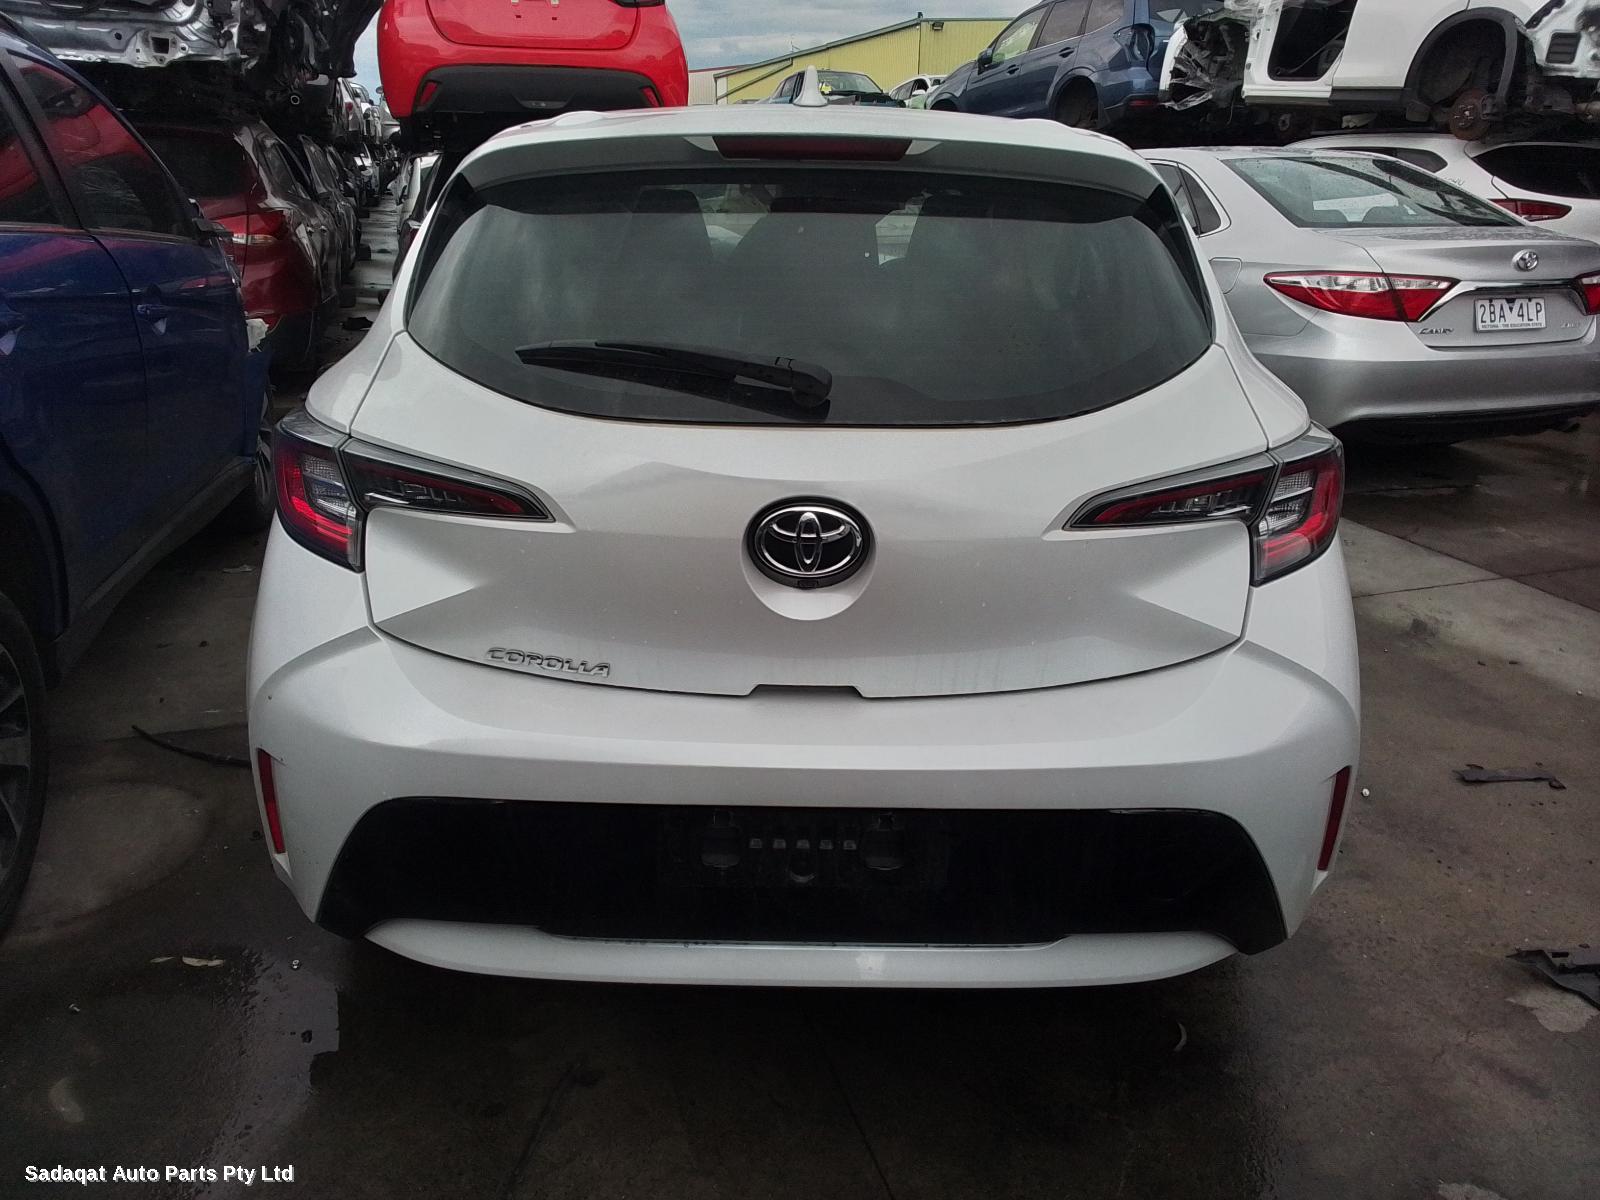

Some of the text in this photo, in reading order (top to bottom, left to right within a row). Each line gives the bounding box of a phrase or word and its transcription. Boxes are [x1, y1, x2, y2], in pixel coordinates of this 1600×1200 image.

[1480, 302, 1542, 323] 2BA 4LP
[485, 647, 610, 678] COROLLA
